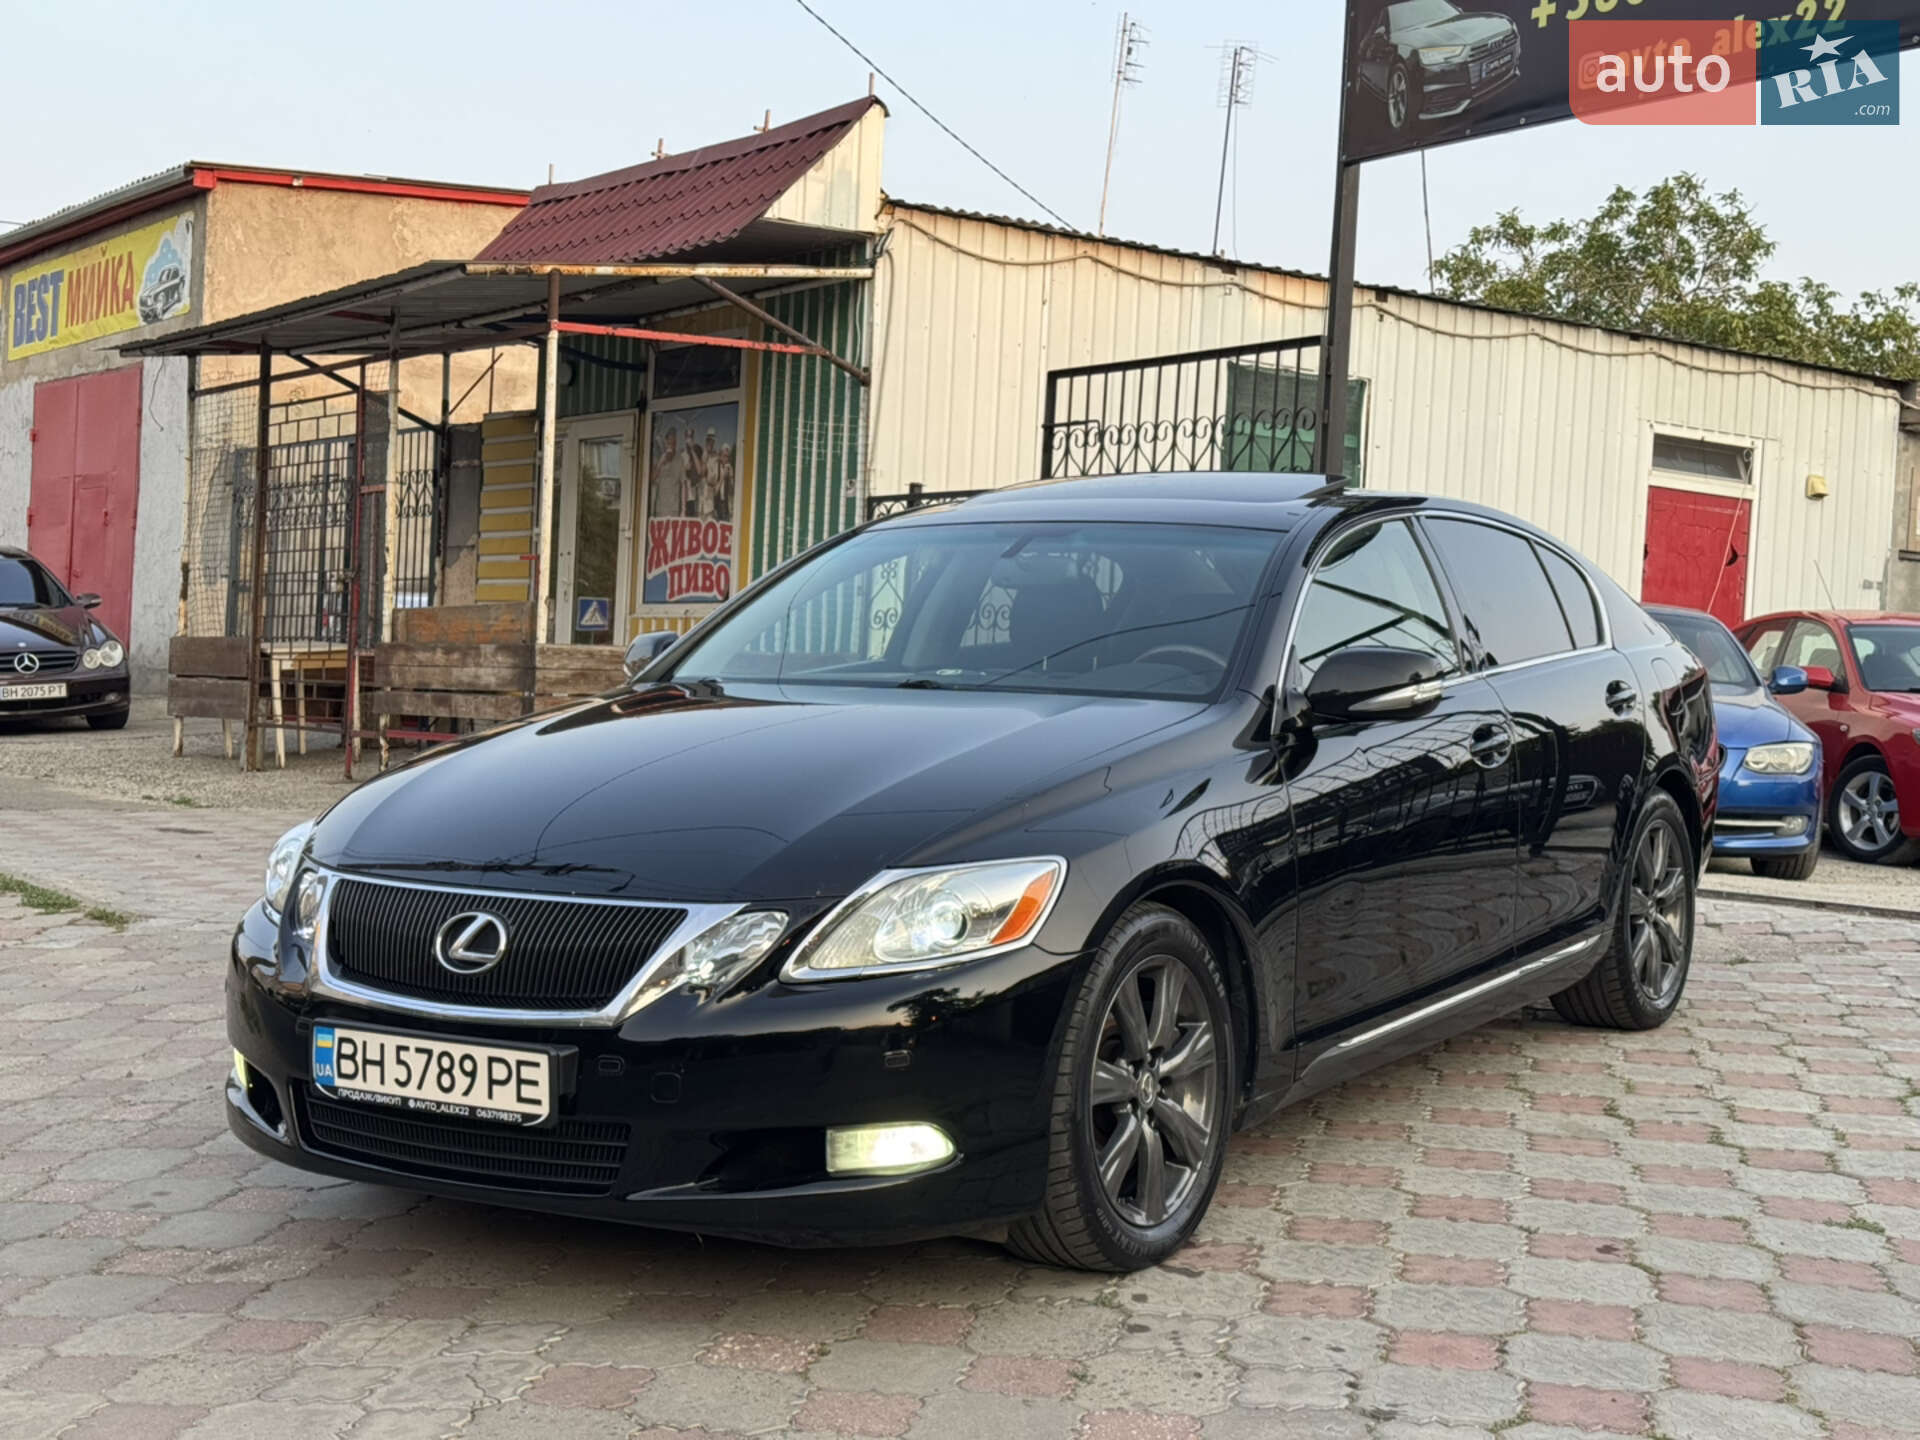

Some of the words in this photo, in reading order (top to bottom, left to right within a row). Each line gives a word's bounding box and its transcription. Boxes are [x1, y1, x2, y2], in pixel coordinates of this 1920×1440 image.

[13, 268, 64, 348] BEST
[65, 246, 135, 328] МИЙКА
[647, 519, 733, 572] ЖИВОЕ
[667, 562, 730, 600] ПИВО
[2, 687, 18, 698] BH
[20, 685, 46, 697] 2075
[48, 684, 65, 696] PT
[316, 1063, 333, 1077] UA
[336, 1036, 386, 1086] BH
[393, 1044, 478, 1097] 5789
[487, 1055, 543, 1107] PE
